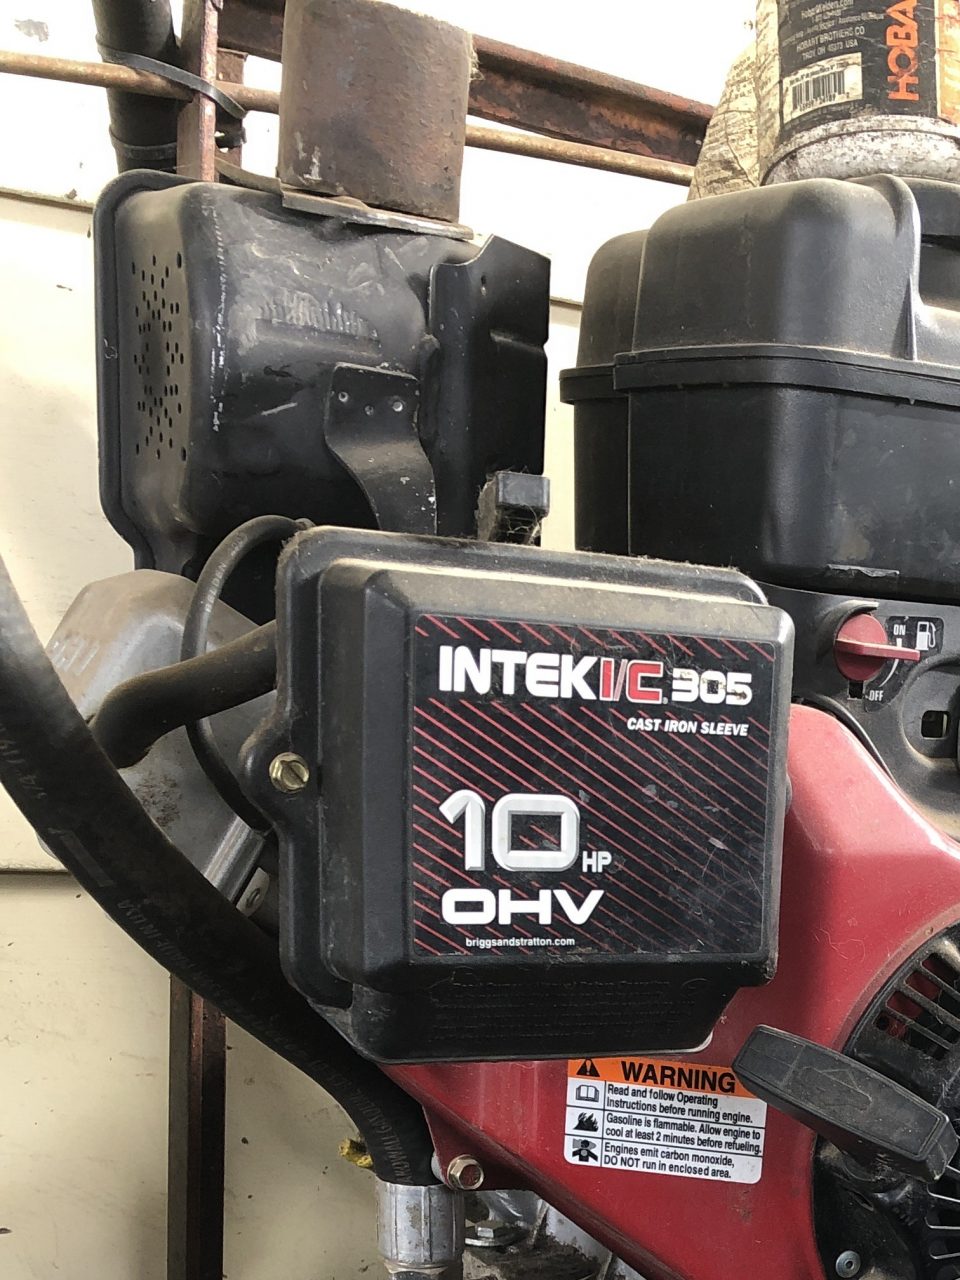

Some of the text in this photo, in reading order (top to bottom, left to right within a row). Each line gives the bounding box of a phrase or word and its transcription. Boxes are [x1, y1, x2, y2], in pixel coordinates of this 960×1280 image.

[854, 26, 865, 35] CO
[845, 39, 858, 49] USA
[893, 623, 906, 636] ON
[439, 645, 600, 700] INTEK
[670, 668, 753, 705] 305
[868, 689, 884, 702] OFF
[627, 716, 748, 737] CAST IRON SLEEVE
[438, 789, 612, 873] 10 HP
[441, 888, 605, 925] OHV
[465, 936, 576, 948] briggsandstratton.com
[621, 1060, 736, 1093] WARNING
[607, 1084, 718, 1108] Read and follow Operating
[607, 1097, 753, 1125] Instructions before running engine.
[606, 1113, 761, 1141] Gasoline is flammable. Allow engine to
[605, 1127, 762, 1155] cool at least 2 minutes before refueling.
[604, 1142, 735, 1168] Engines emit carbon monoxide,
[604, 1154, 732, 1179] DO NOT run in enclosed area.
